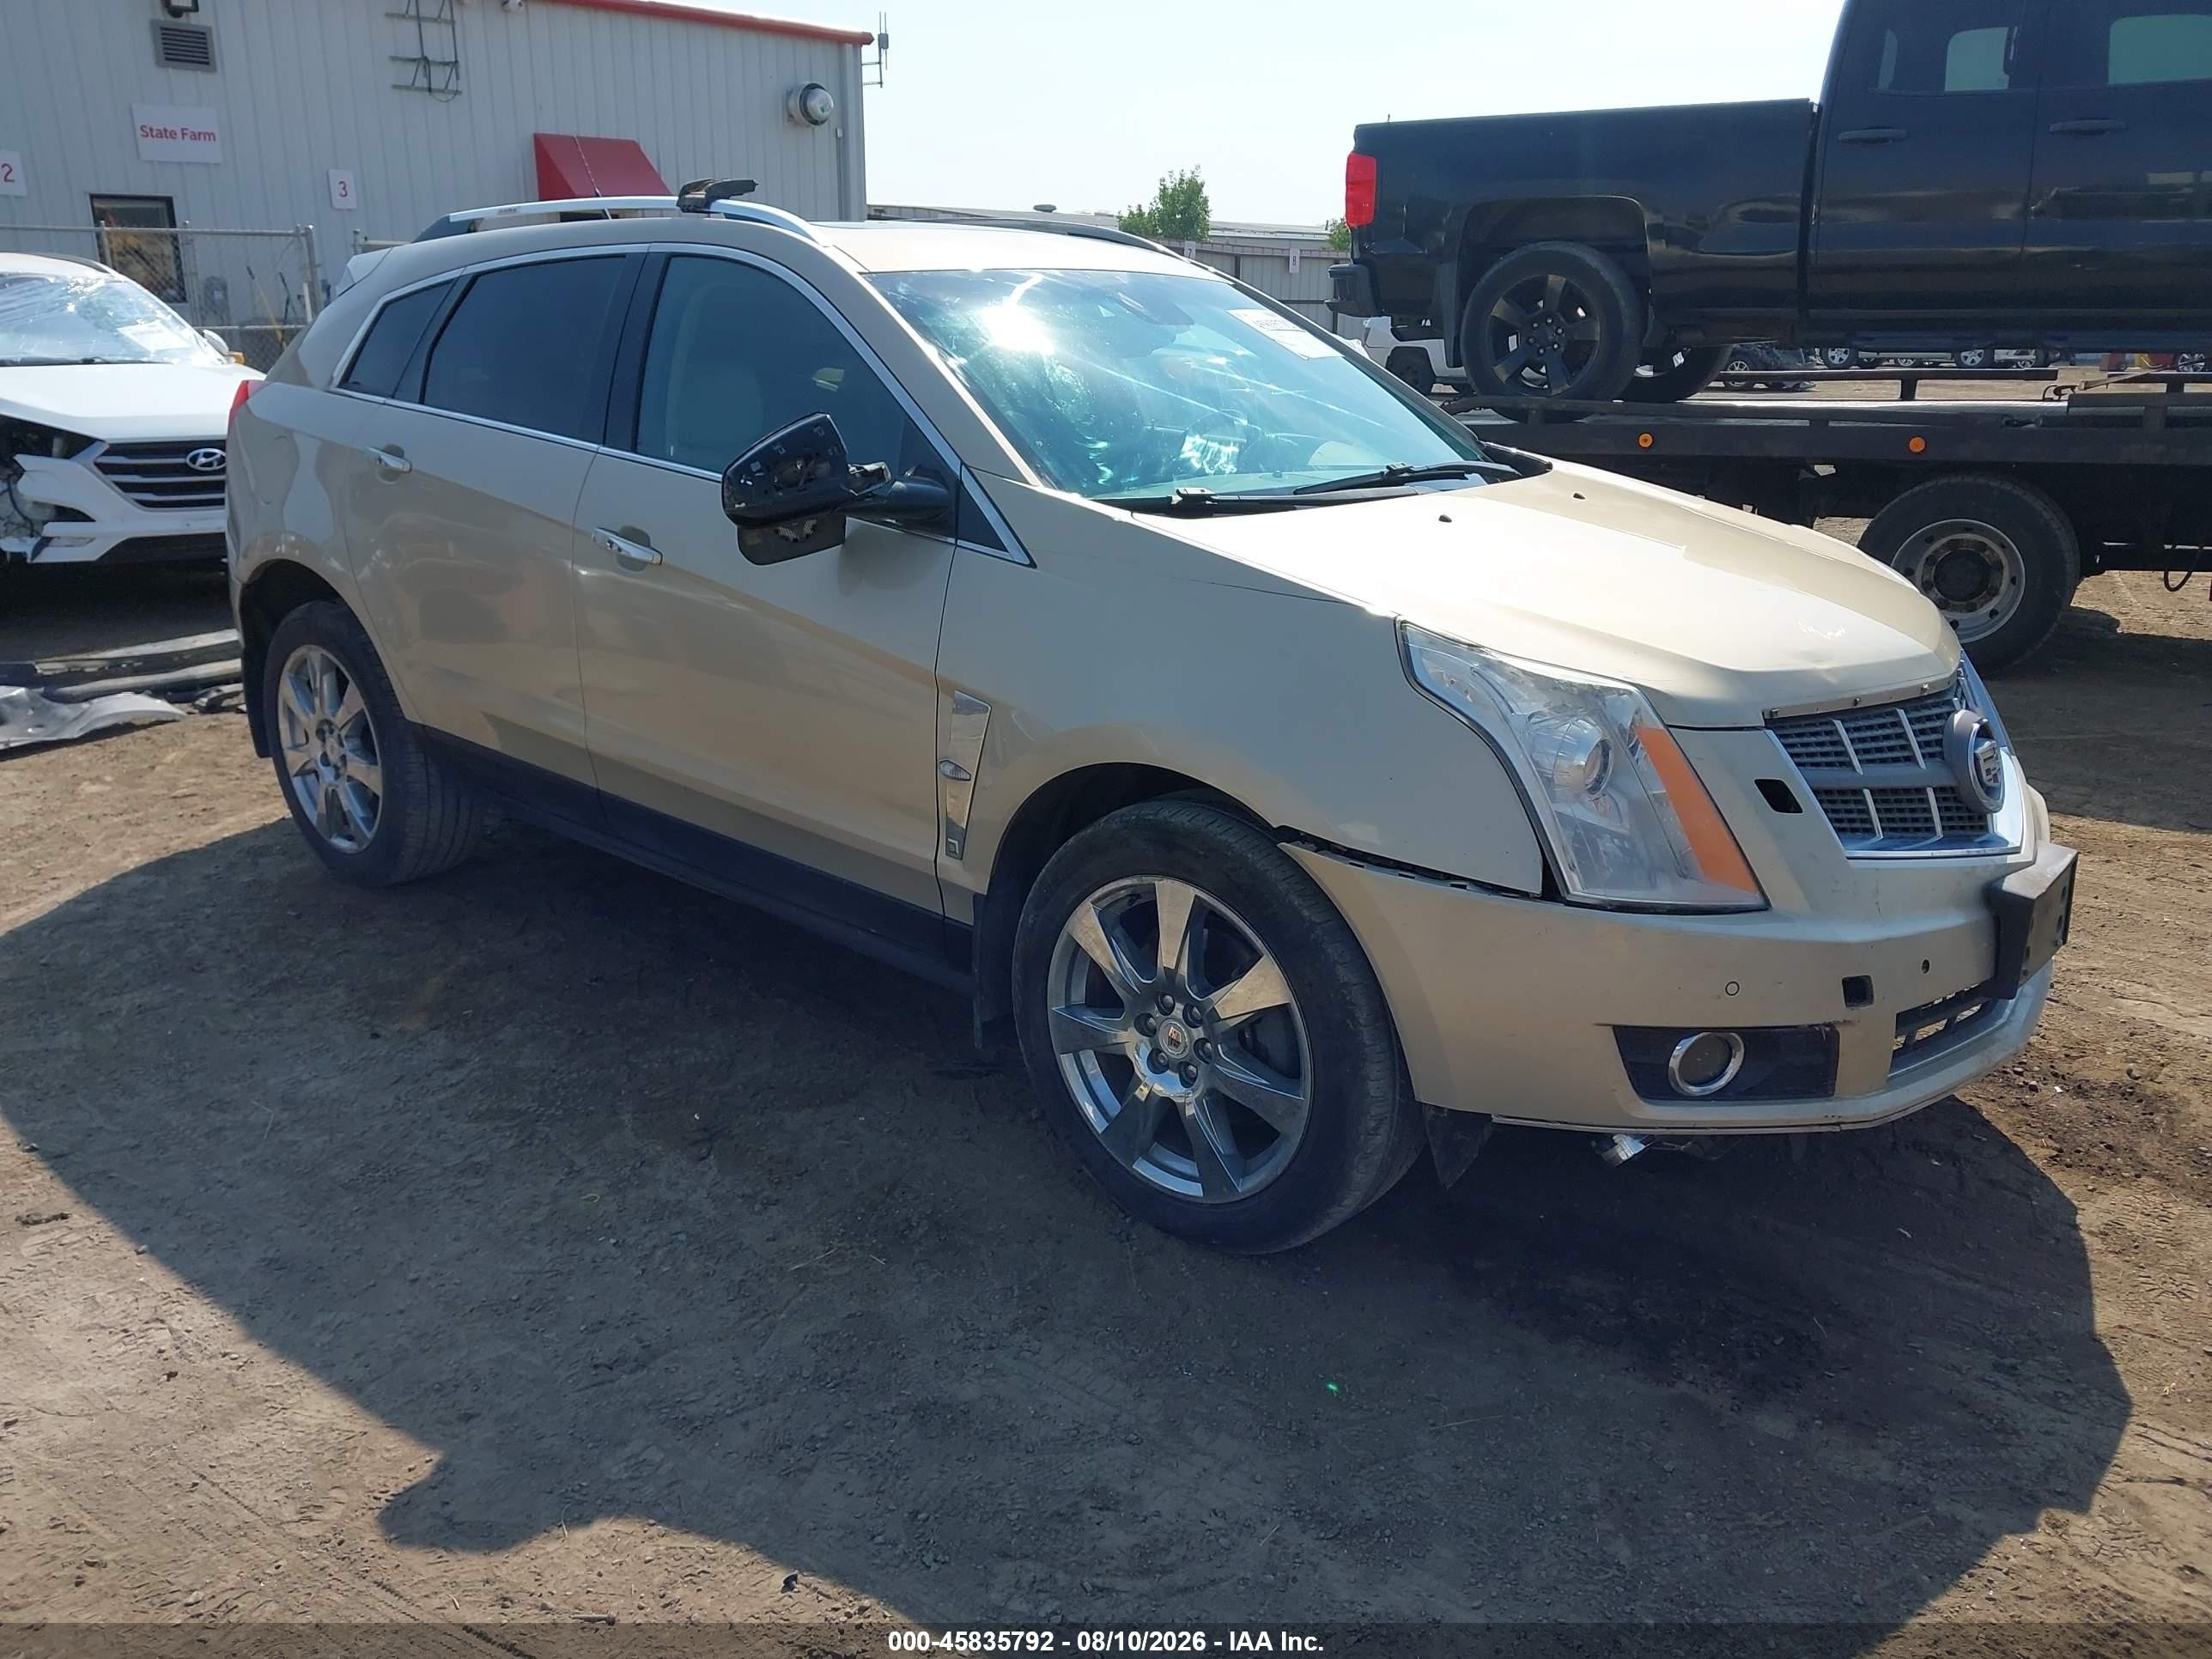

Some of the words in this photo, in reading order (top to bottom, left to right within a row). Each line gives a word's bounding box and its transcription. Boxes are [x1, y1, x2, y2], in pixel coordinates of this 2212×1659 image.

[139, 125, 178, 139] State
[180, 127, 216, 142] Farm
[1, 163, 15, 183] 2
[338, 180, 348, 198] 3
[1291, 255, 1297, 266] 8
